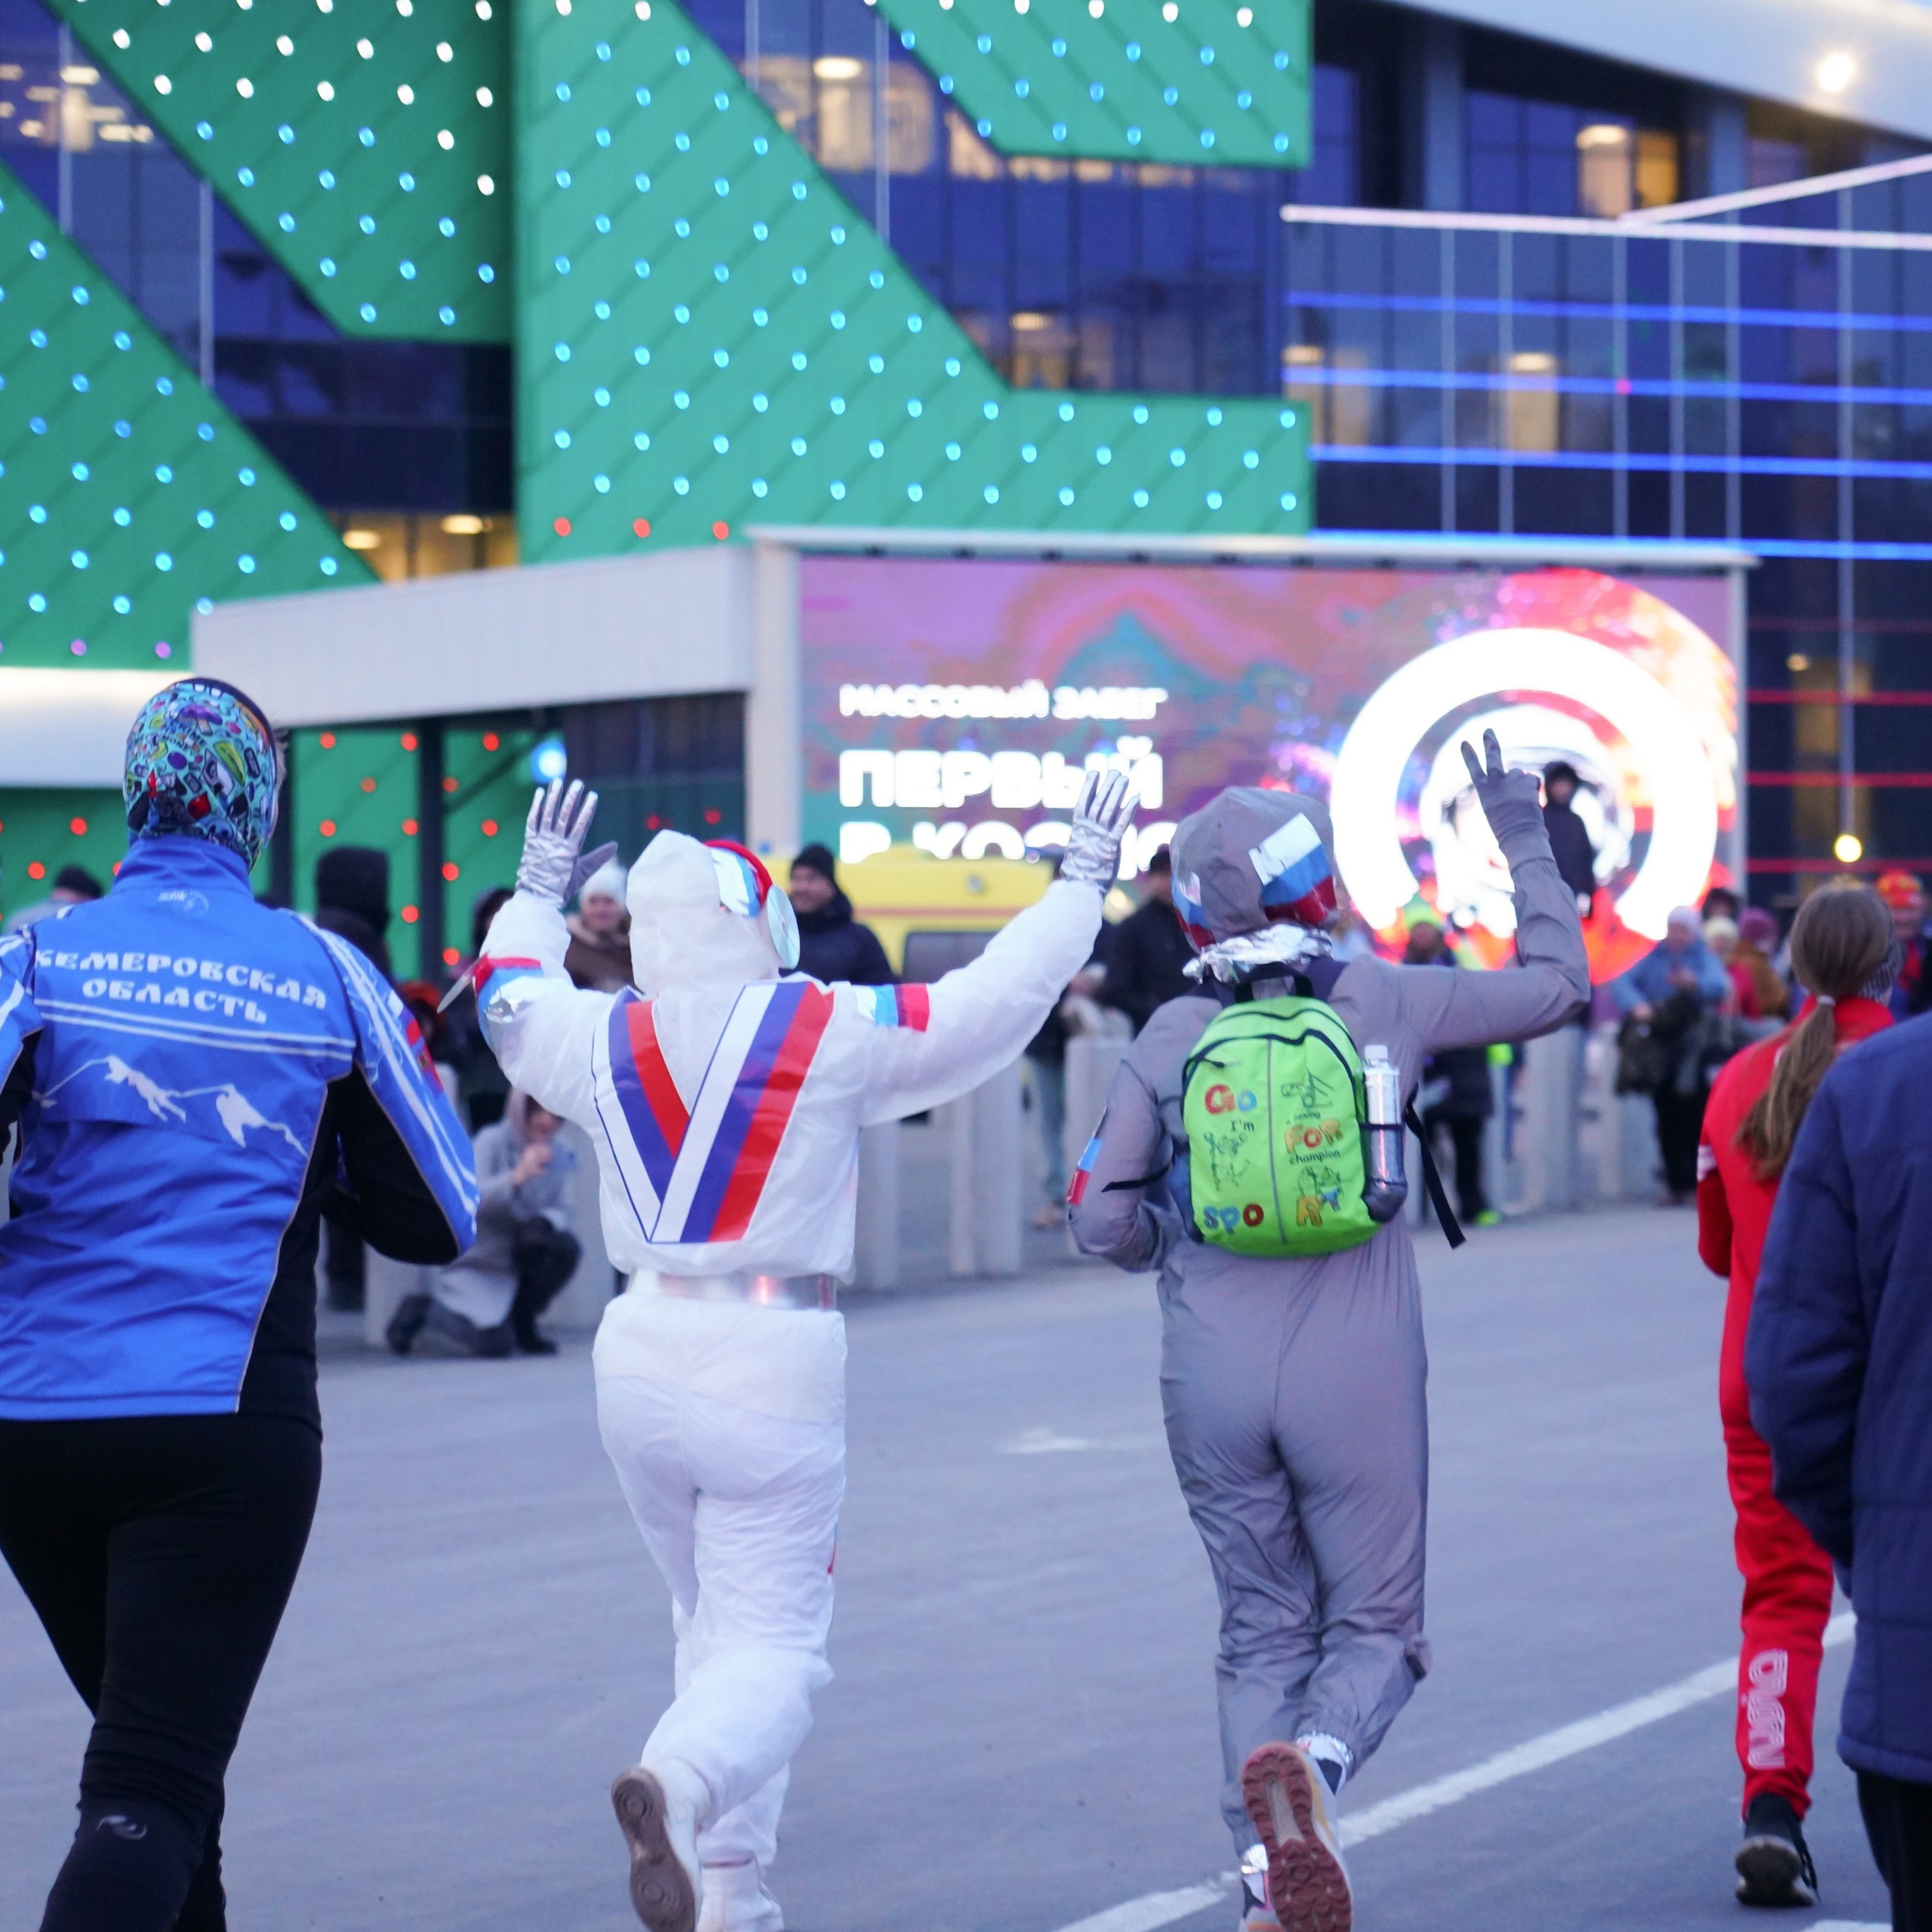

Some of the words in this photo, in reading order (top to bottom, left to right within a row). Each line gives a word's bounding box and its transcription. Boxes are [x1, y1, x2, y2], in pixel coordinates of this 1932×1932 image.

[839, 735, 1164, 810] ПЕРВЫЙ
[35, 949, 327, 1011] КЕМЕРОВСКАЯ
[82, 977, 268, 1025] ОБЛАСТЬ
[1289, 1149, 1341, 1165] champion
